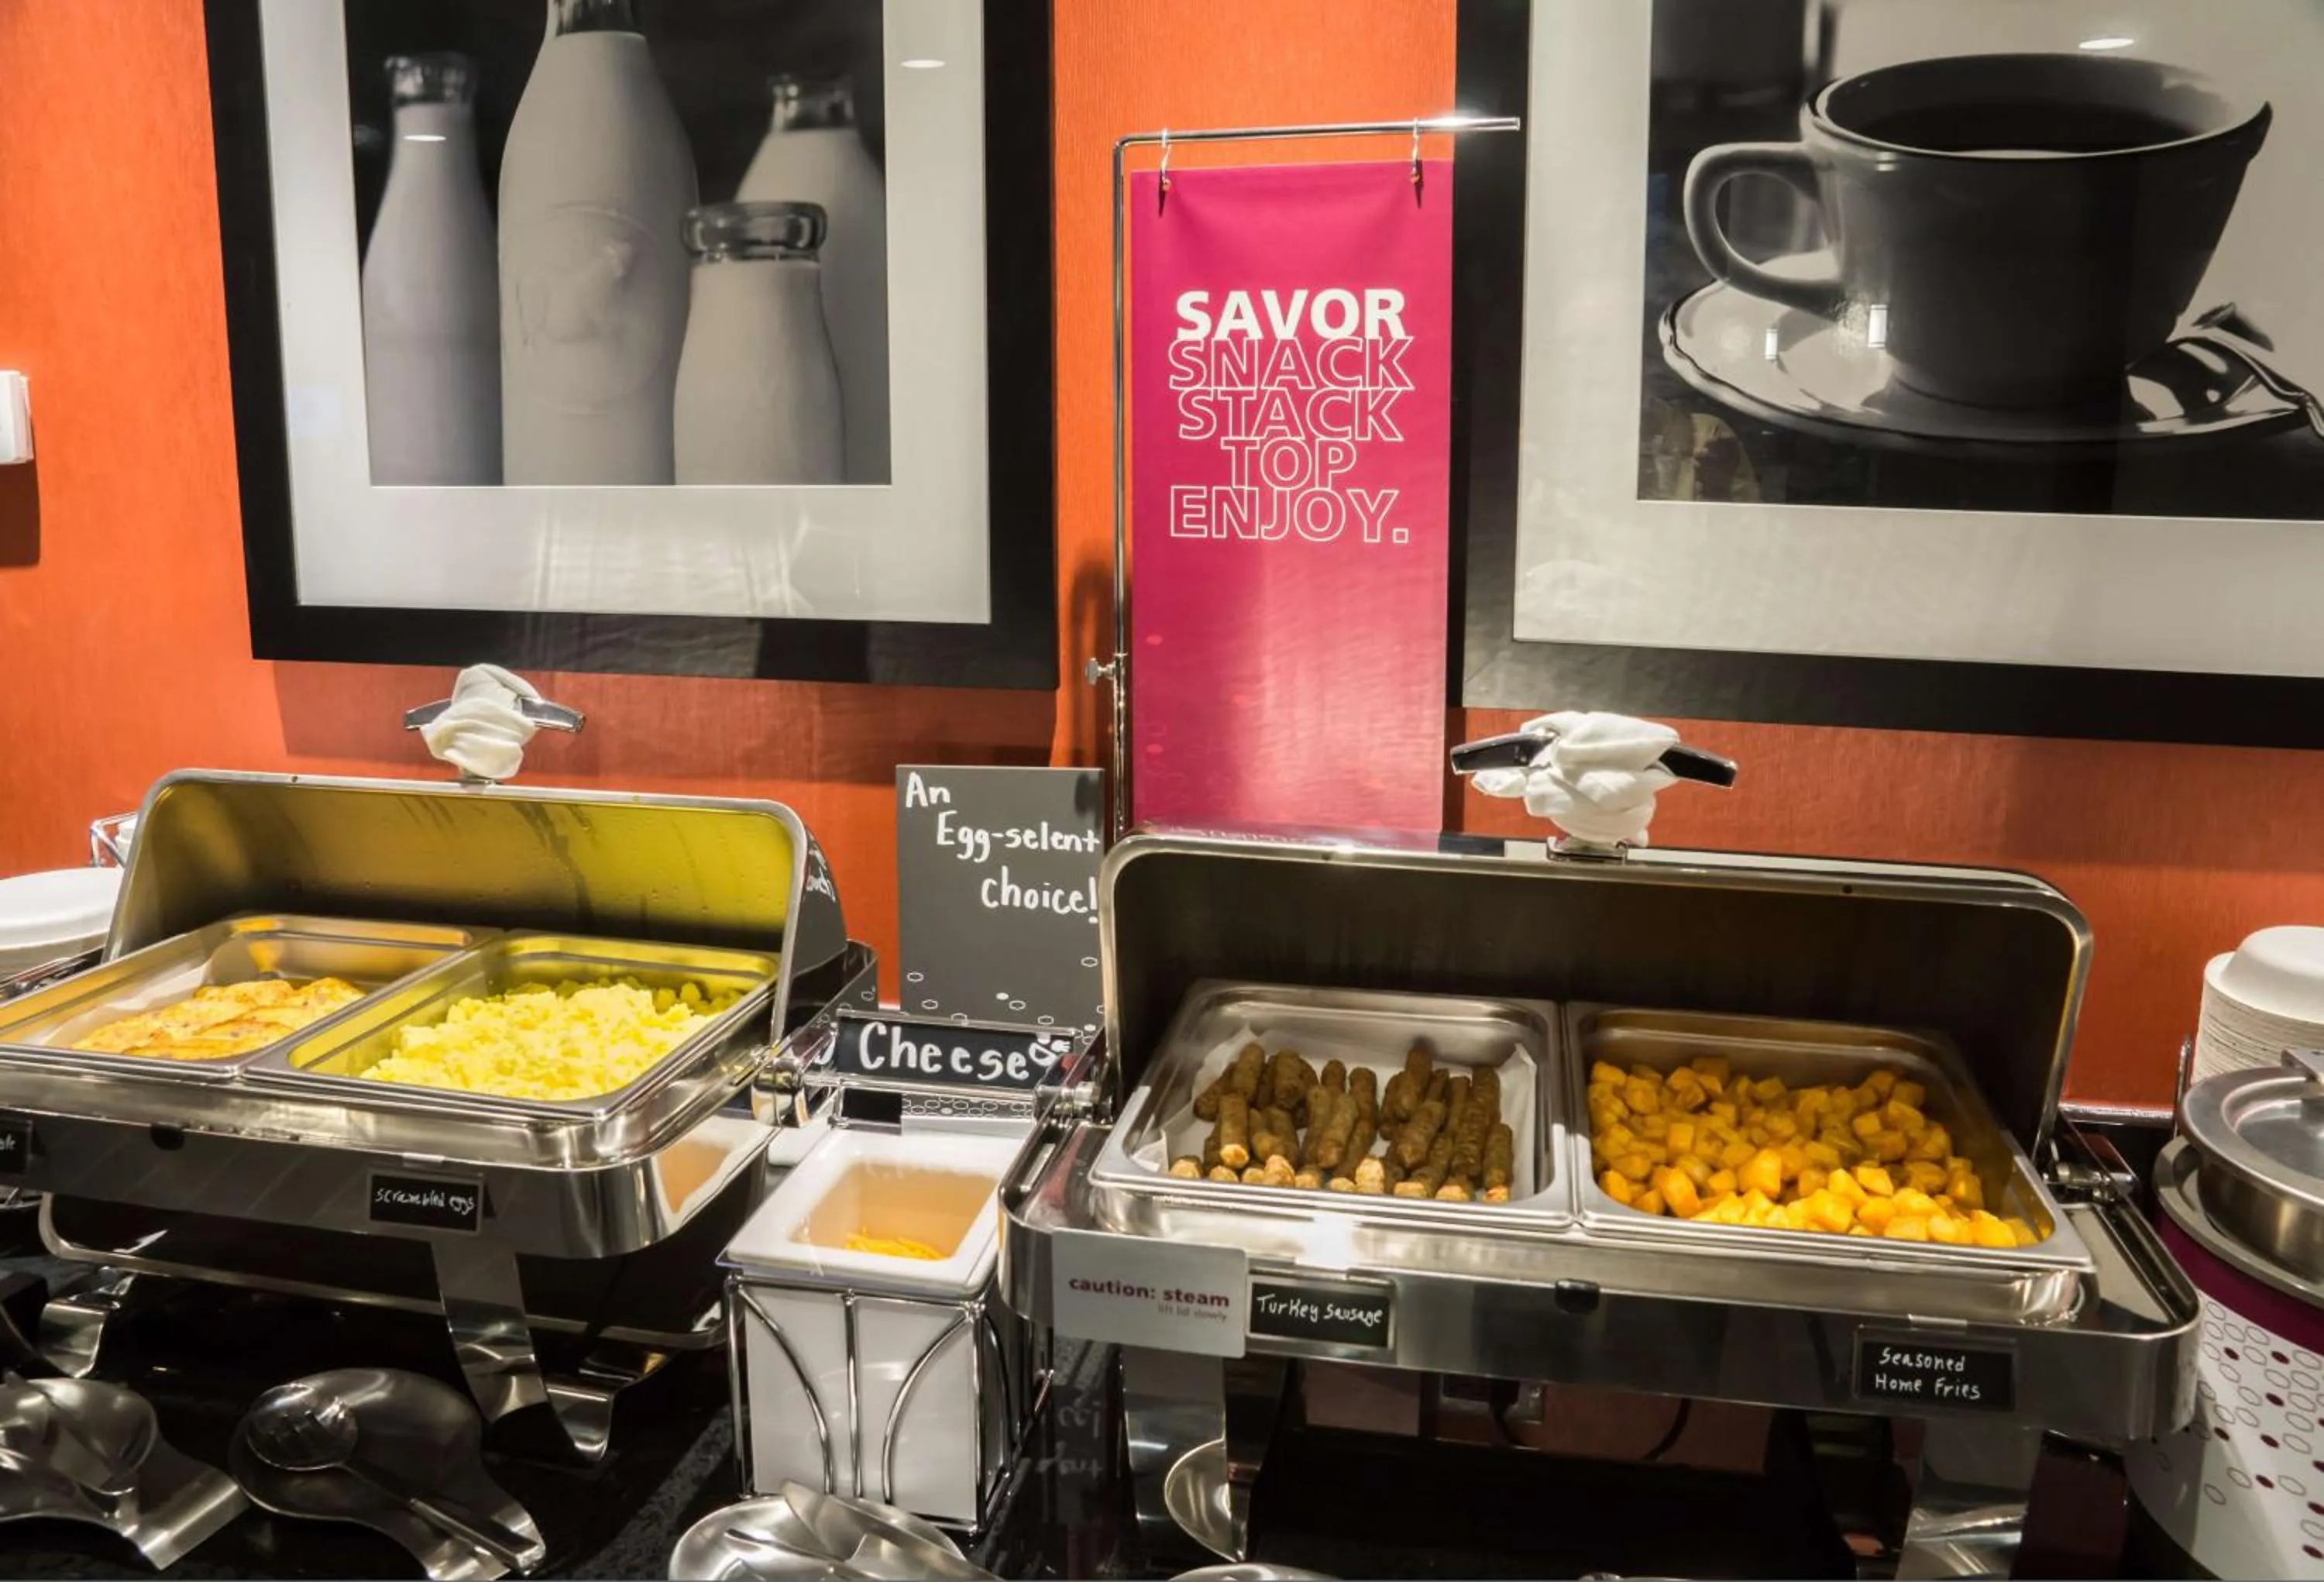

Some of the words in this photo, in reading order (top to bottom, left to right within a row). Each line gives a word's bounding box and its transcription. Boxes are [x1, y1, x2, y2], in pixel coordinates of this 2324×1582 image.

[1176, 288, 1405, 339] SAVOR
[1169, 336, 1415, 390] SNACK
[1179, 387, 1404, 441] STACK
[1221, 437, 1356, 490] TOP
[1171, 486, 1409, 543] ENJOY.
[906, 772, 951, 808] An
[937, 810, 1100, 863] Egg-selent
[858, 1021, 1030, 1081] Cheese
[1068, 1276, 1156, 1300] caution:
[1163, 1288, 1229, 1307] steam
[1879, 1346, 1965, 1372] Seasoned
[1875, 1373, 1922, 1391] Home
[1934, 1377, 1981, 1400] Fries
